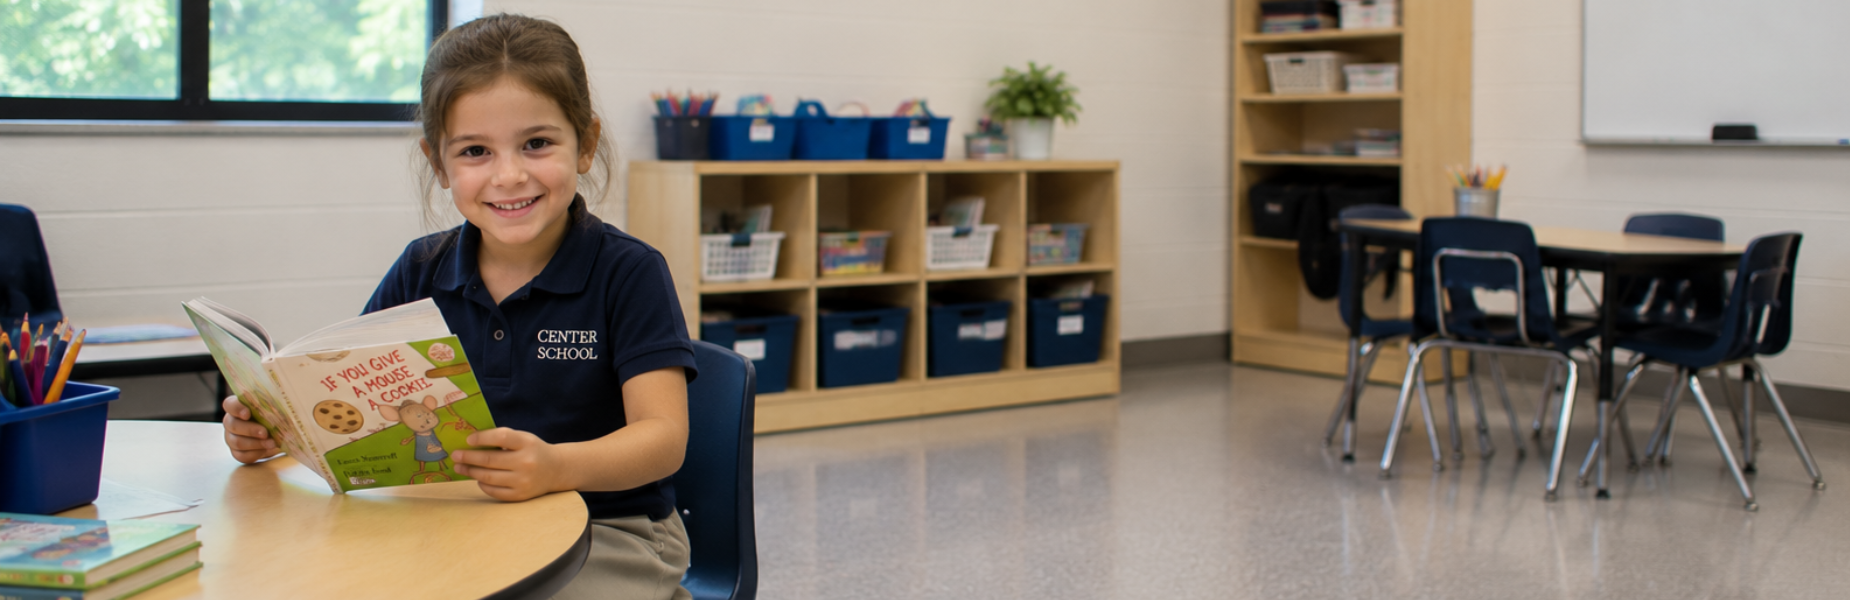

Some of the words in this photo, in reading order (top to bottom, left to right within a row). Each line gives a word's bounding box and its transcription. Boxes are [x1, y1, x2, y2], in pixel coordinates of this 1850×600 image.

[537, 329, 598, 343] CENTER
[537, 346, 598, 360] SCHOOL
[320, 375, 338, 392] IF
[336, 363, 369, 383] YOU
[369, 349, 405, 371] GIVE
[352, 385, 367, 398] A
[368, 398, 380, 411] A
